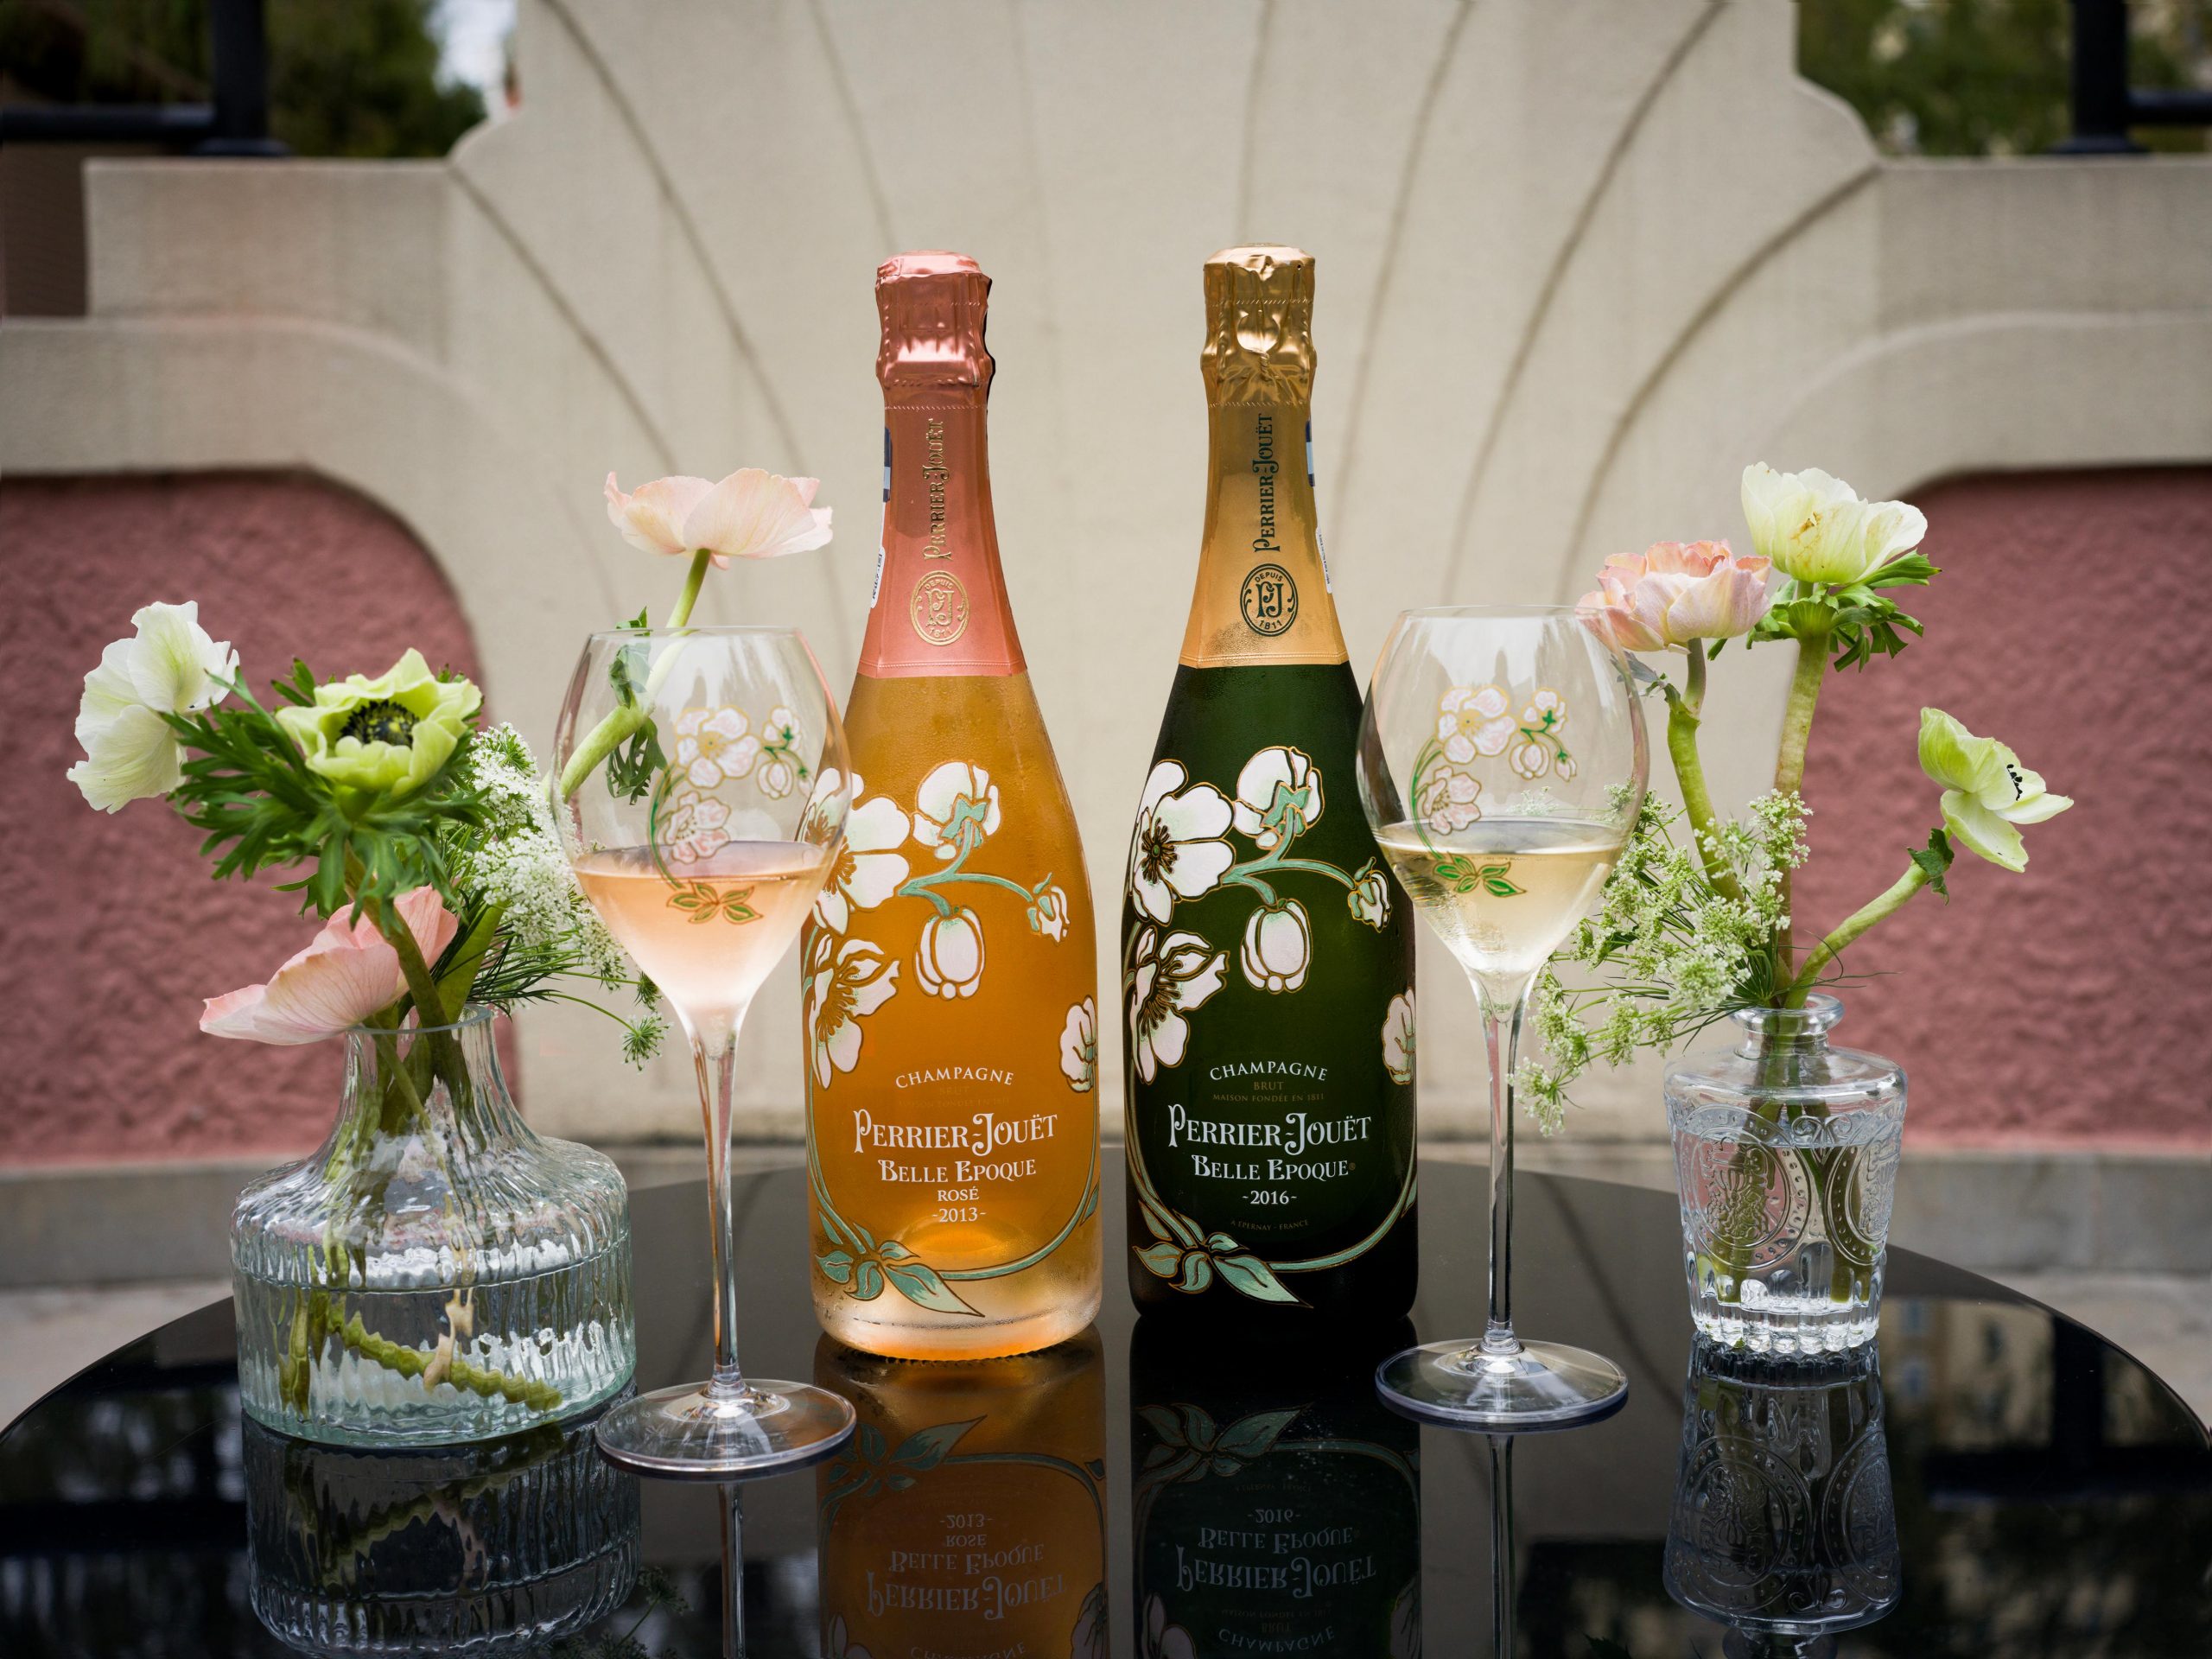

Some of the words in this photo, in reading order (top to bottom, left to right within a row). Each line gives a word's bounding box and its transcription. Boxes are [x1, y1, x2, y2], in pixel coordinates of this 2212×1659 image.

[1253, 413, 1281, 552] PERRIER-JOUËT
[1255, 571, 1283, 582] DEPUIS
[925, 579, 954, 591] DEPUIS
[1258, 619, 1282, 630] 1811
[895, 1066, 1014, 1089] CHAMPAGNE
[1210, 1060, 1328, 1081] CHAMPAGNE
[1253, 1081, 1285, 1090] BRUT
[1212, 1093, 1249, 1103] MAISON
[1292, 1093, 1303, 1102] EN
[1307, 1092, 1324, 1102] 1811
[853, 1109, 1058, 1156] PERRIER-JOUËT
[1167, 1103, 1371, 1156] PERRIER-JOUËT
[878, 1159, 949, 1183] BELLE
[955, 1159, 1037, 1182] EPOQUE
[1191, 1154, 1261, 1180] BELLE
[938, 1186, 979, 1202] ROSÉ
[1243, 1190, 1297, 1205] -2016-
[931, 1207, 987, 1223] -2013-
[1279, 1219, 1309, 1230] FRANCE
